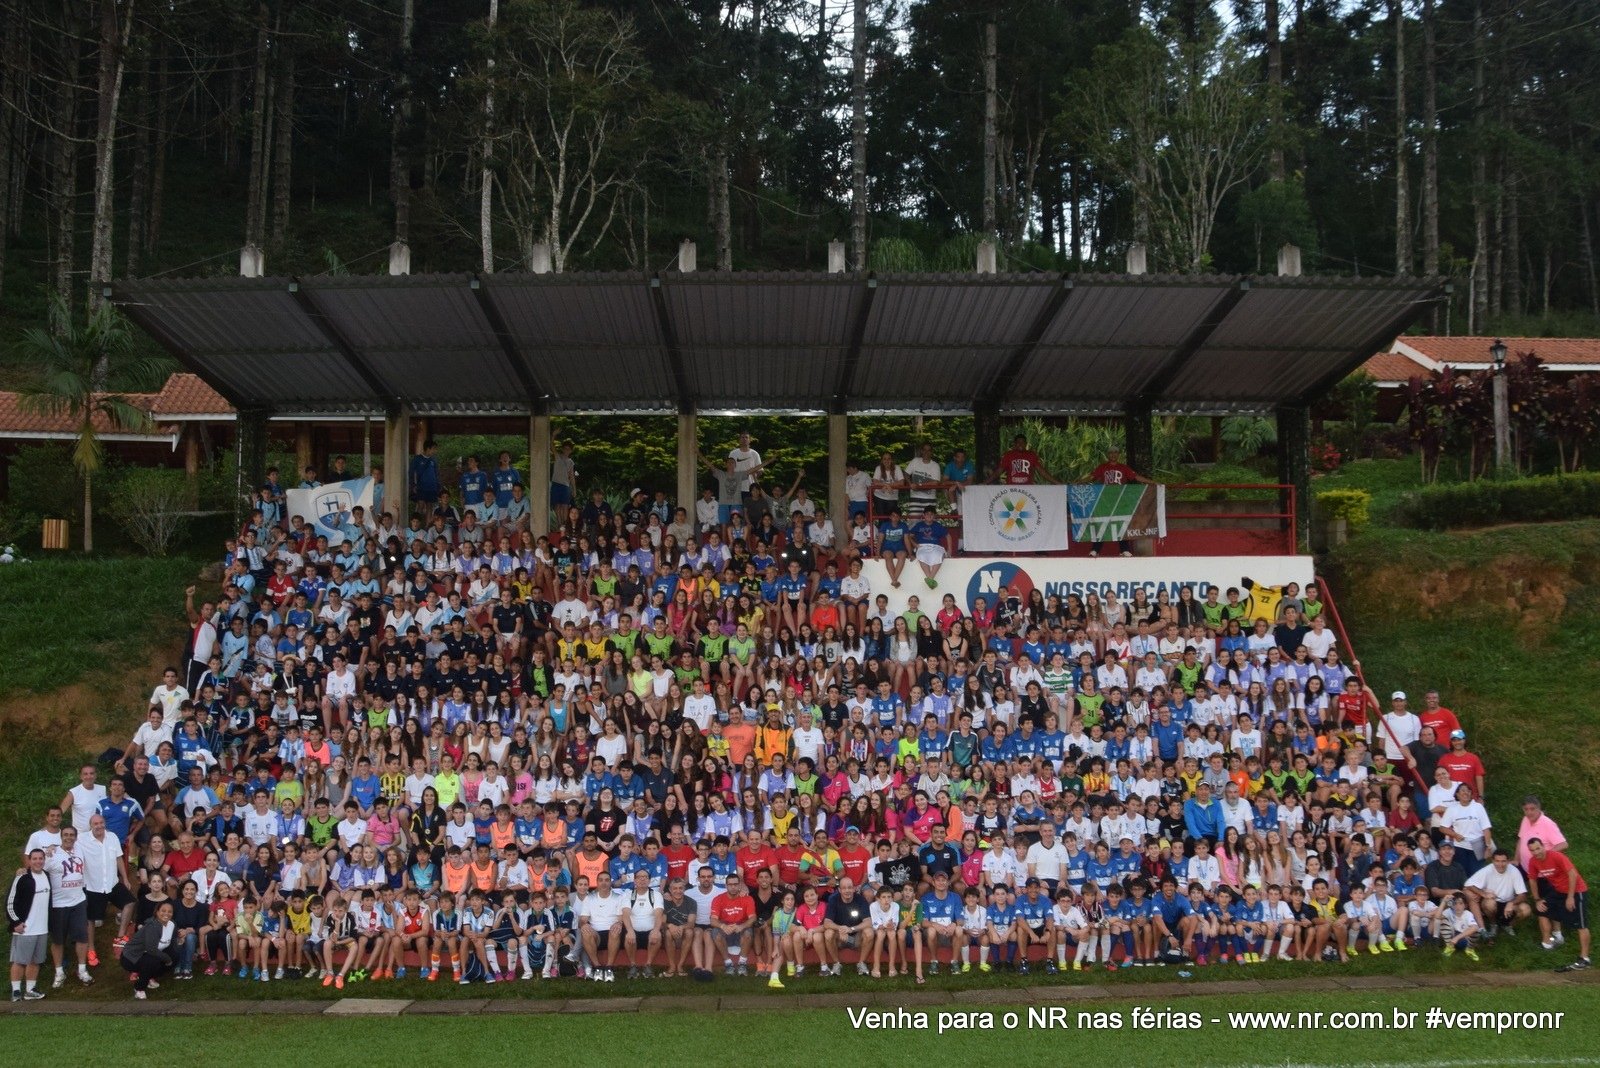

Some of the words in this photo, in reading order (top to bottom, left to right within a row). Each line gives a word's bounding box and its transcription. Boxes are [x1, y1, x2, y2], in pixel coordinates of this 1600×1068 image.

[1011, 459, 1031, 476] NR
[988, 489, 1008, 526] CONFEDERAÇÃO
[1010, 488, 1038, 505] BRASILEIRA
[1127, 527, 1159, 537] KKL-JNF
[979, 570, 1002, 593] N
[1045, 581, 1112, 600] NOSSO
[1116, 581, 1211, 600] RECANTO
